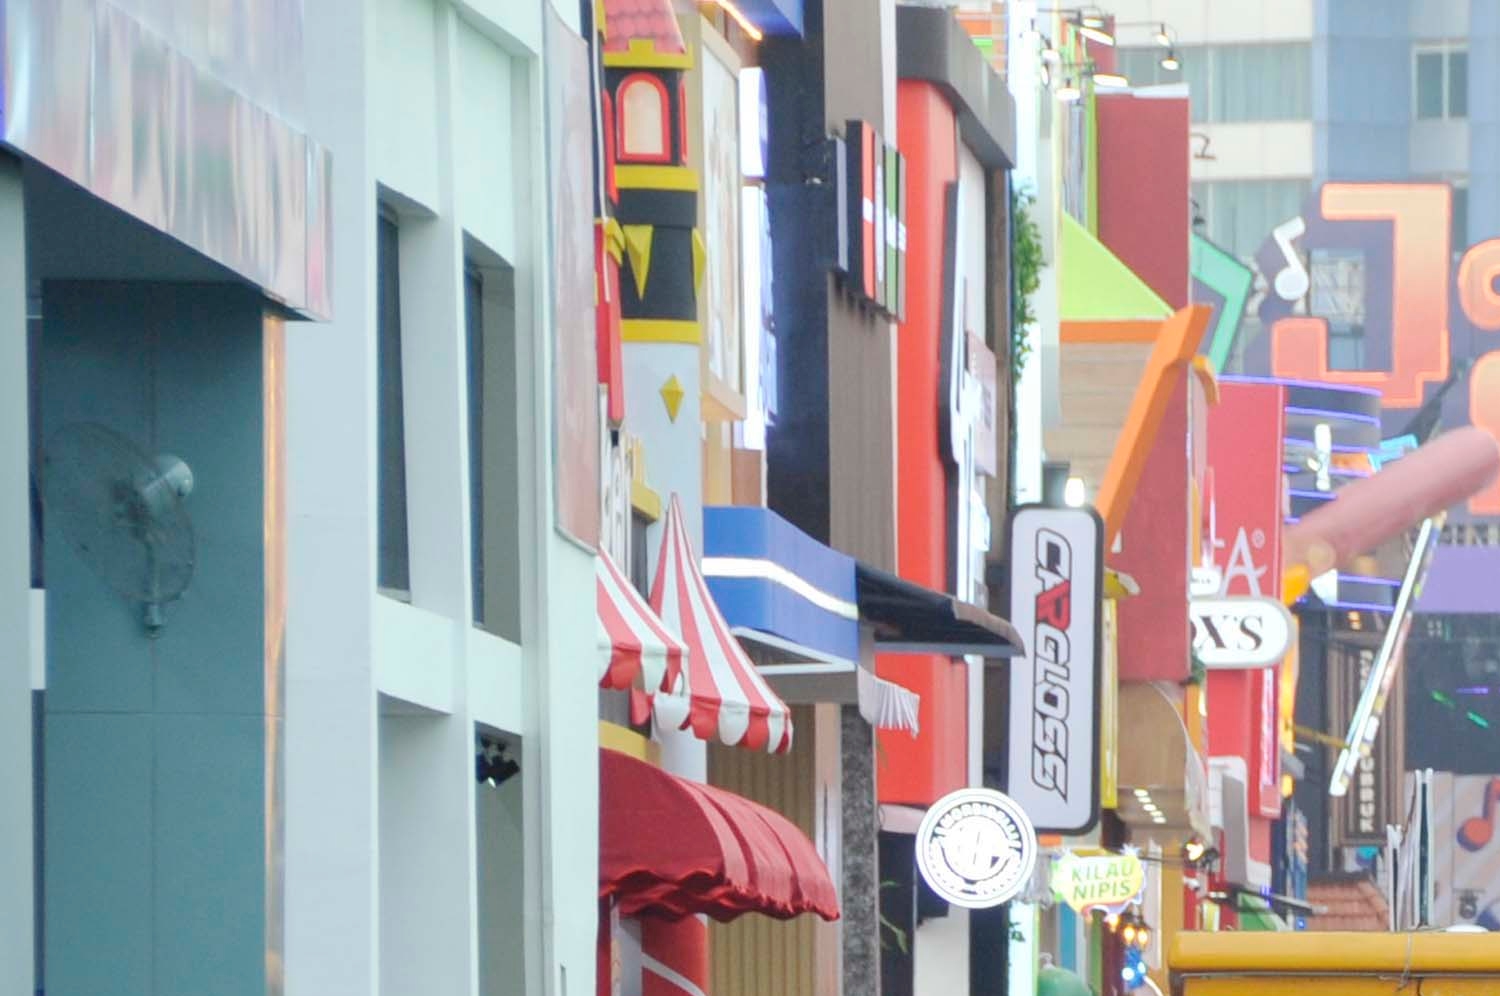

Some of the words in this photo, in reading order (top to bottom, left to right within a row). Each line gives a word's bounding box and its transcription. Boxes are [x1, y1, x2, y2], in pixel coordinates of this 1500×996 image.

[1190, 614, 1264, 651] X'S
[1030, 527, 1073, 804] CARGLOSS
[1072, 861, 1134, 882] KILAU
[1073, 880, 1131, 901] NIPIS
